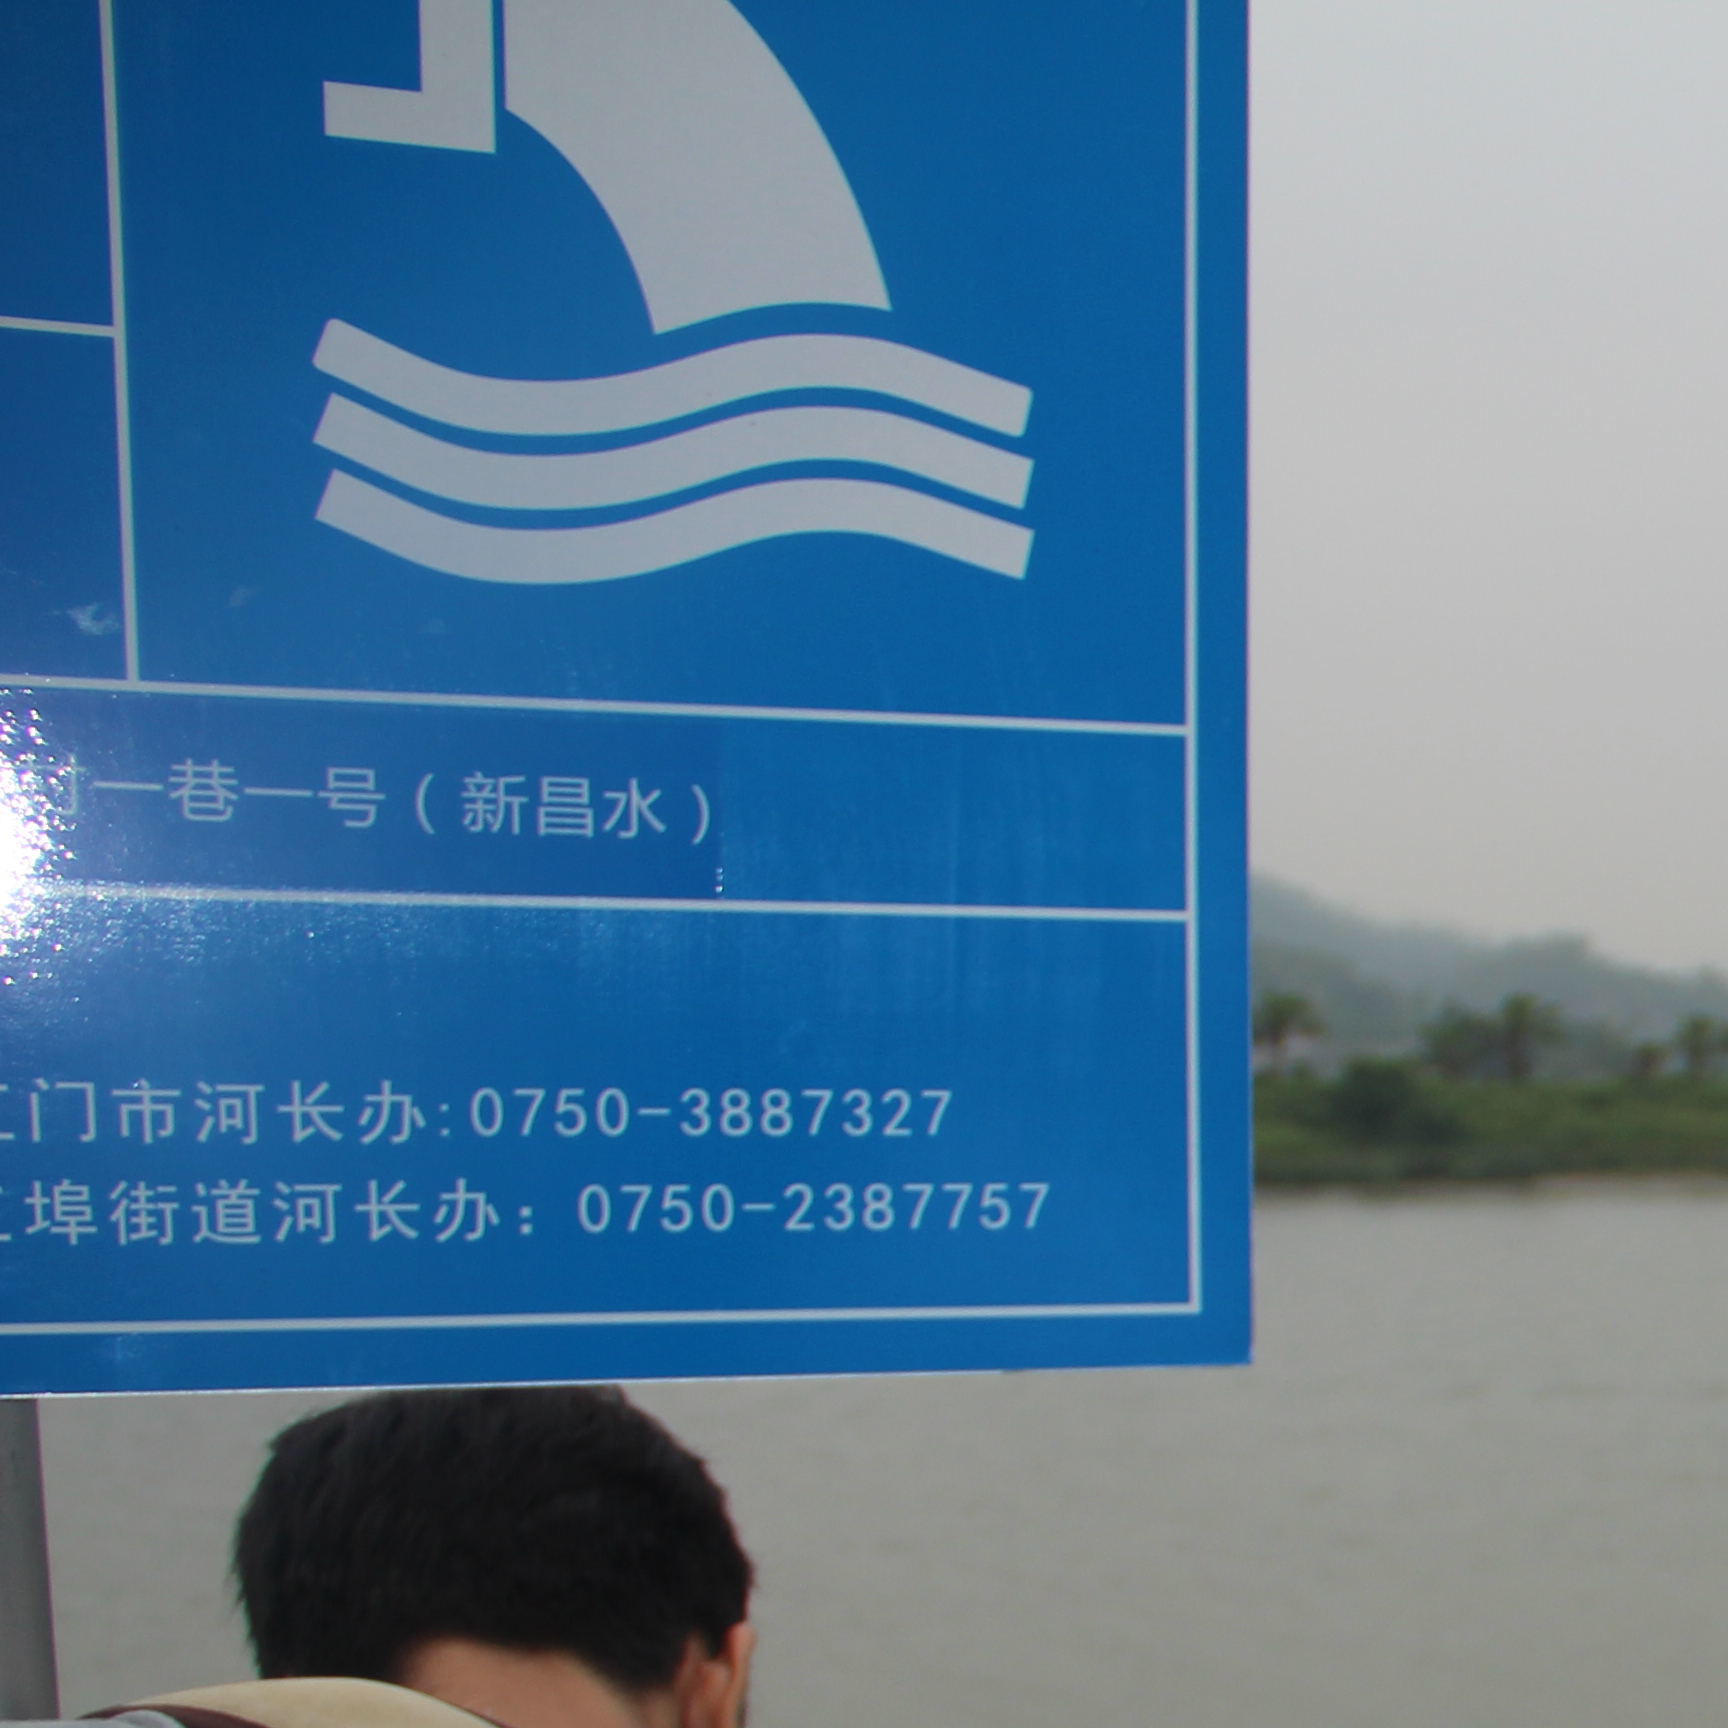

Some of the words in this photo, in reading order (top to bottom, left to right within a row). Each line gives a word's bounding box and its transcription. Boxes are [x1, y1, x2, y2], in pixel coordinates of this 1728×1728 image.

[0, 1176, 1050, 1247] 埠街道河长办：0750-2387757
